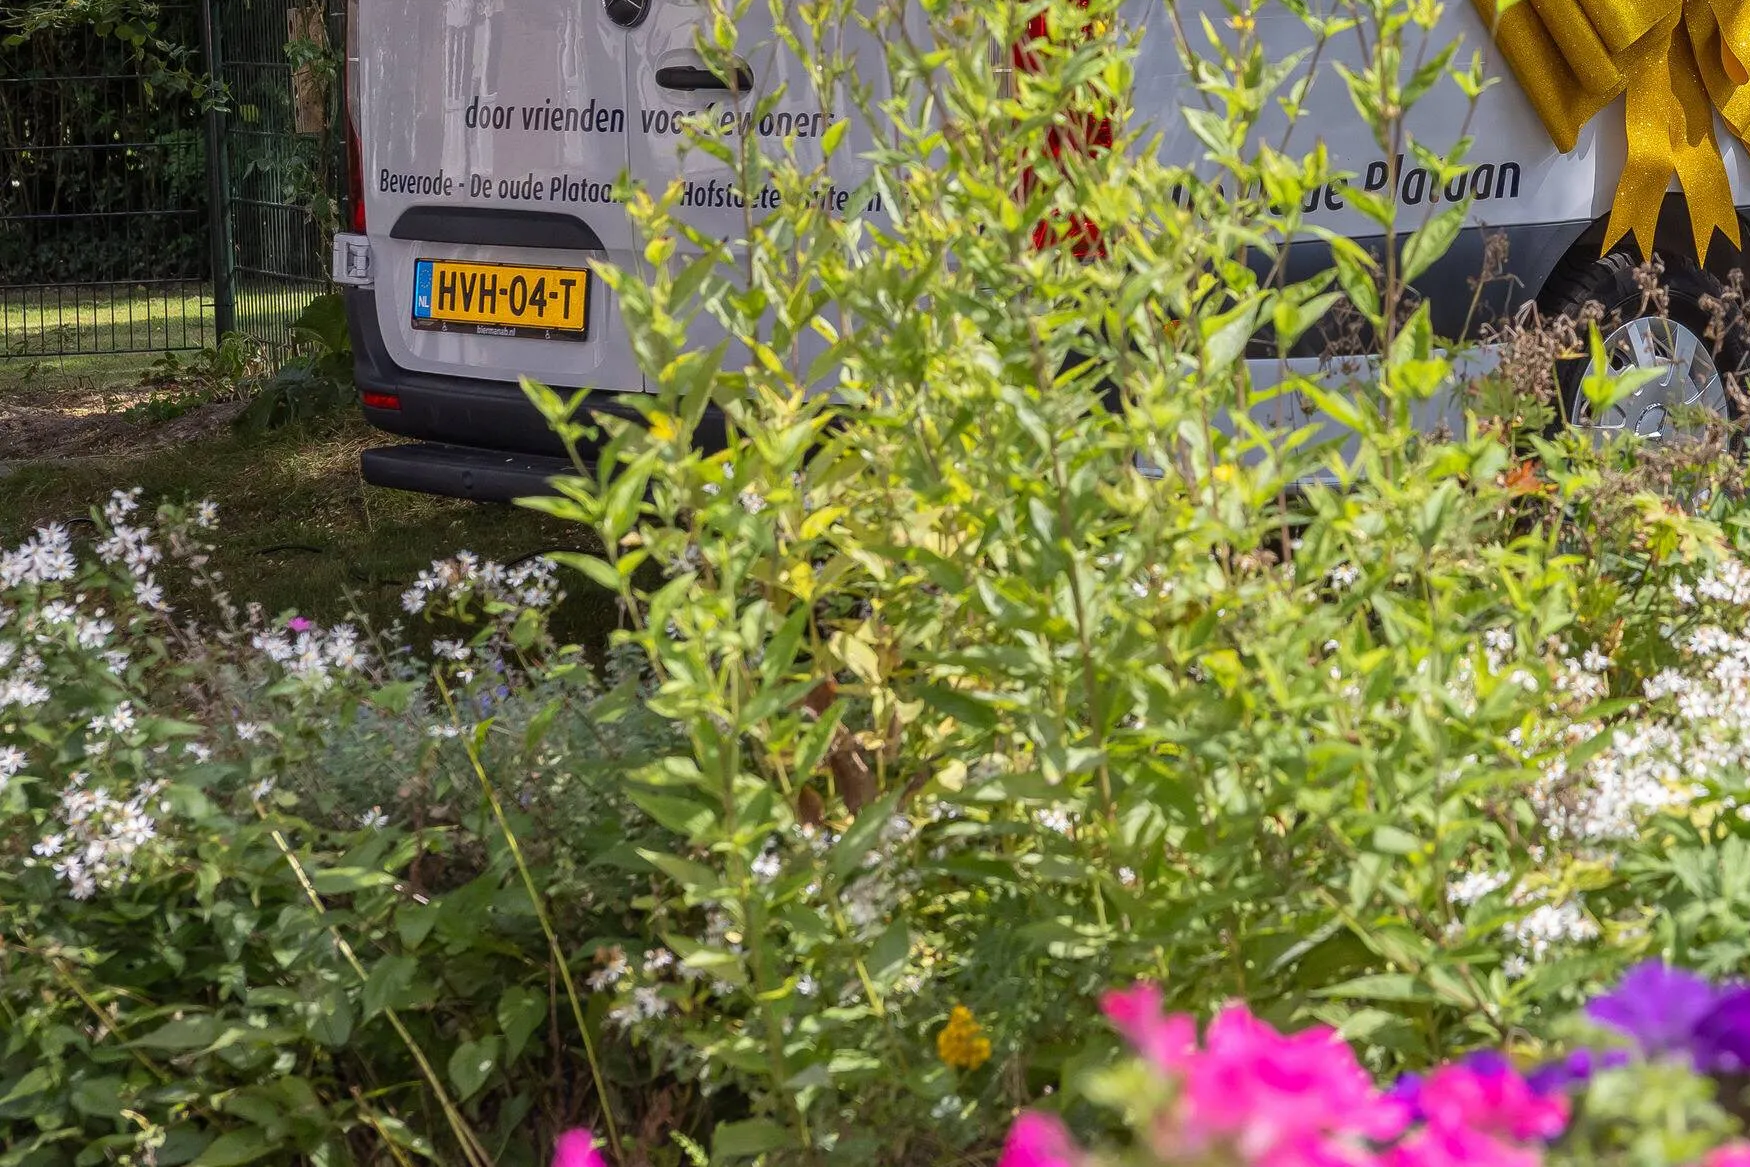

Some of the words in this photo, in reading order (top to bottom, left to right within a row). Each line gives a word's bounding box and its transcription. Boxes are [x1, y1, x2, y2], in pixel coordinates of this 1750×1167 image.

[465, 96, 515, 129] door
[522, 98, 624, 132] vrienden
[641, 109, 698, 135] voo
[380, 168, 452, 196] Beverode
[470, 174, 493, 198] De
[499, 173, 543, 200] oude
[549, 174, 625, 204] Plataa
[418, 295, 430, 308] NL
[437, 270, 577, 320] HVH-04-T
